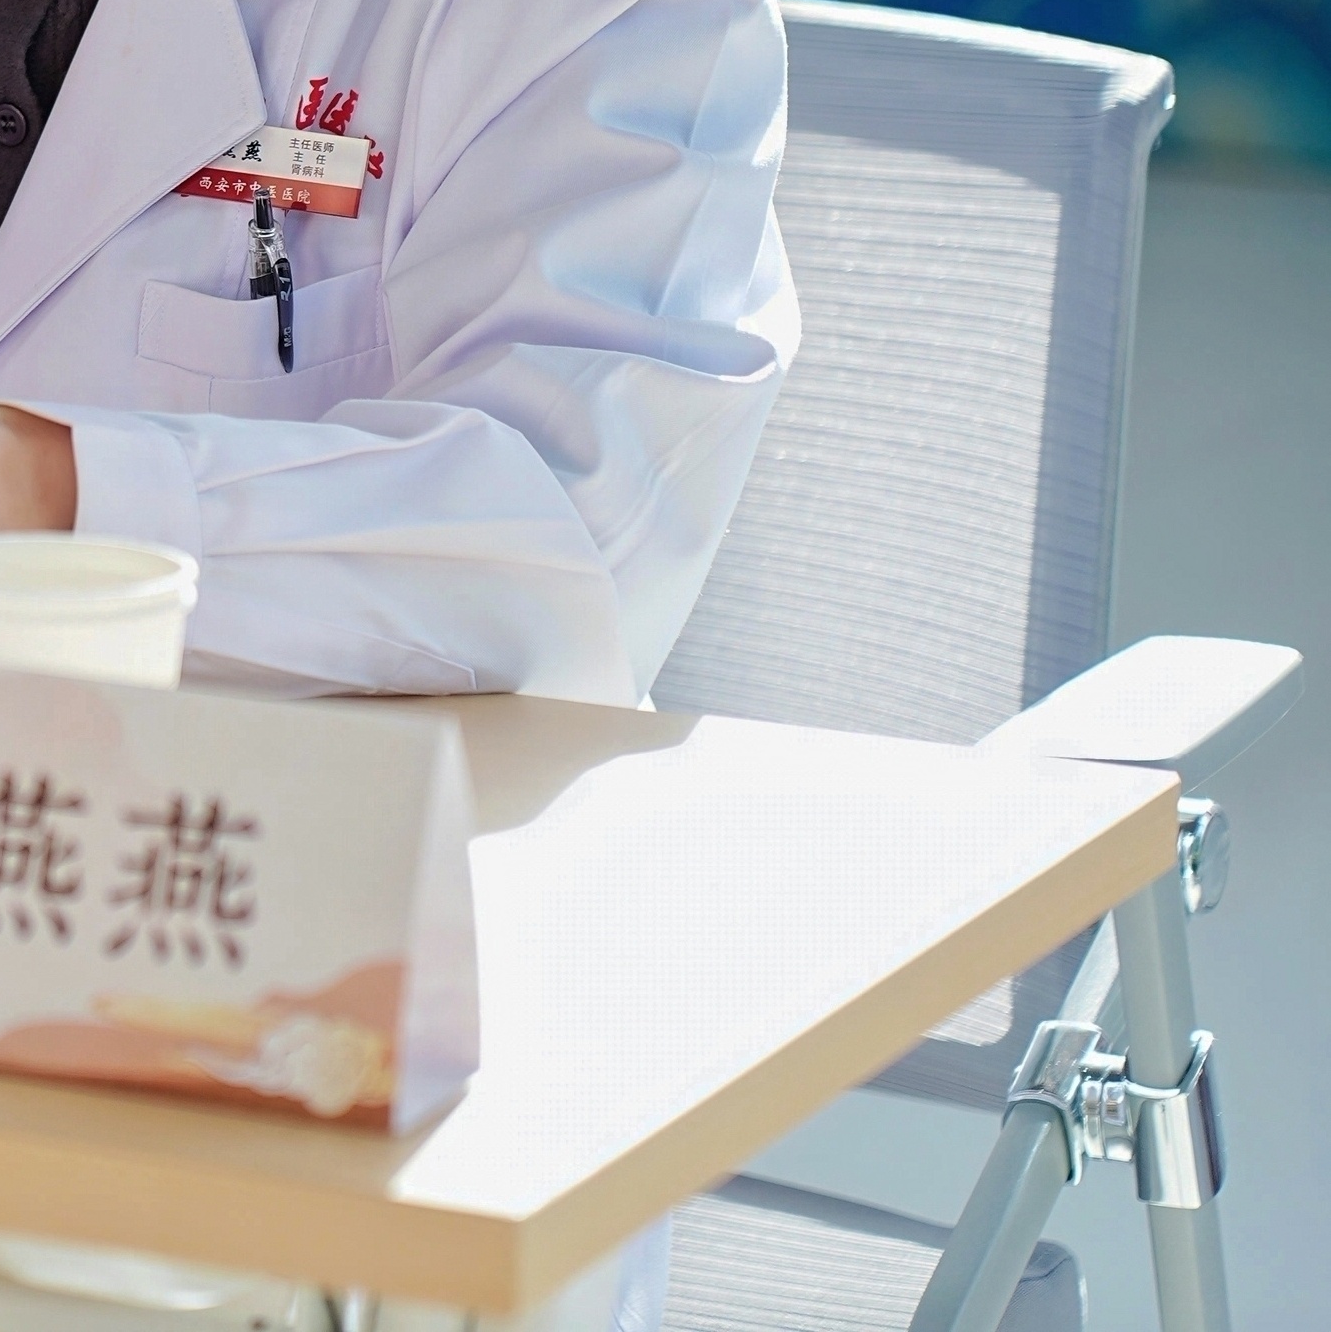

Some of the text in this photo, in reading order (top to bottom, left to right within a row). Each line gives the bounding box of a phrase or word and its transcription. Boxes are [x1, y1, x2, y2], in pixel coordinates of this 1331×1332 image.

[289, 137, 335, 154] 主任医师
[291, 164, 325, 178] 肾病科
[198, 176, 311, 204] 西安市中医医院
